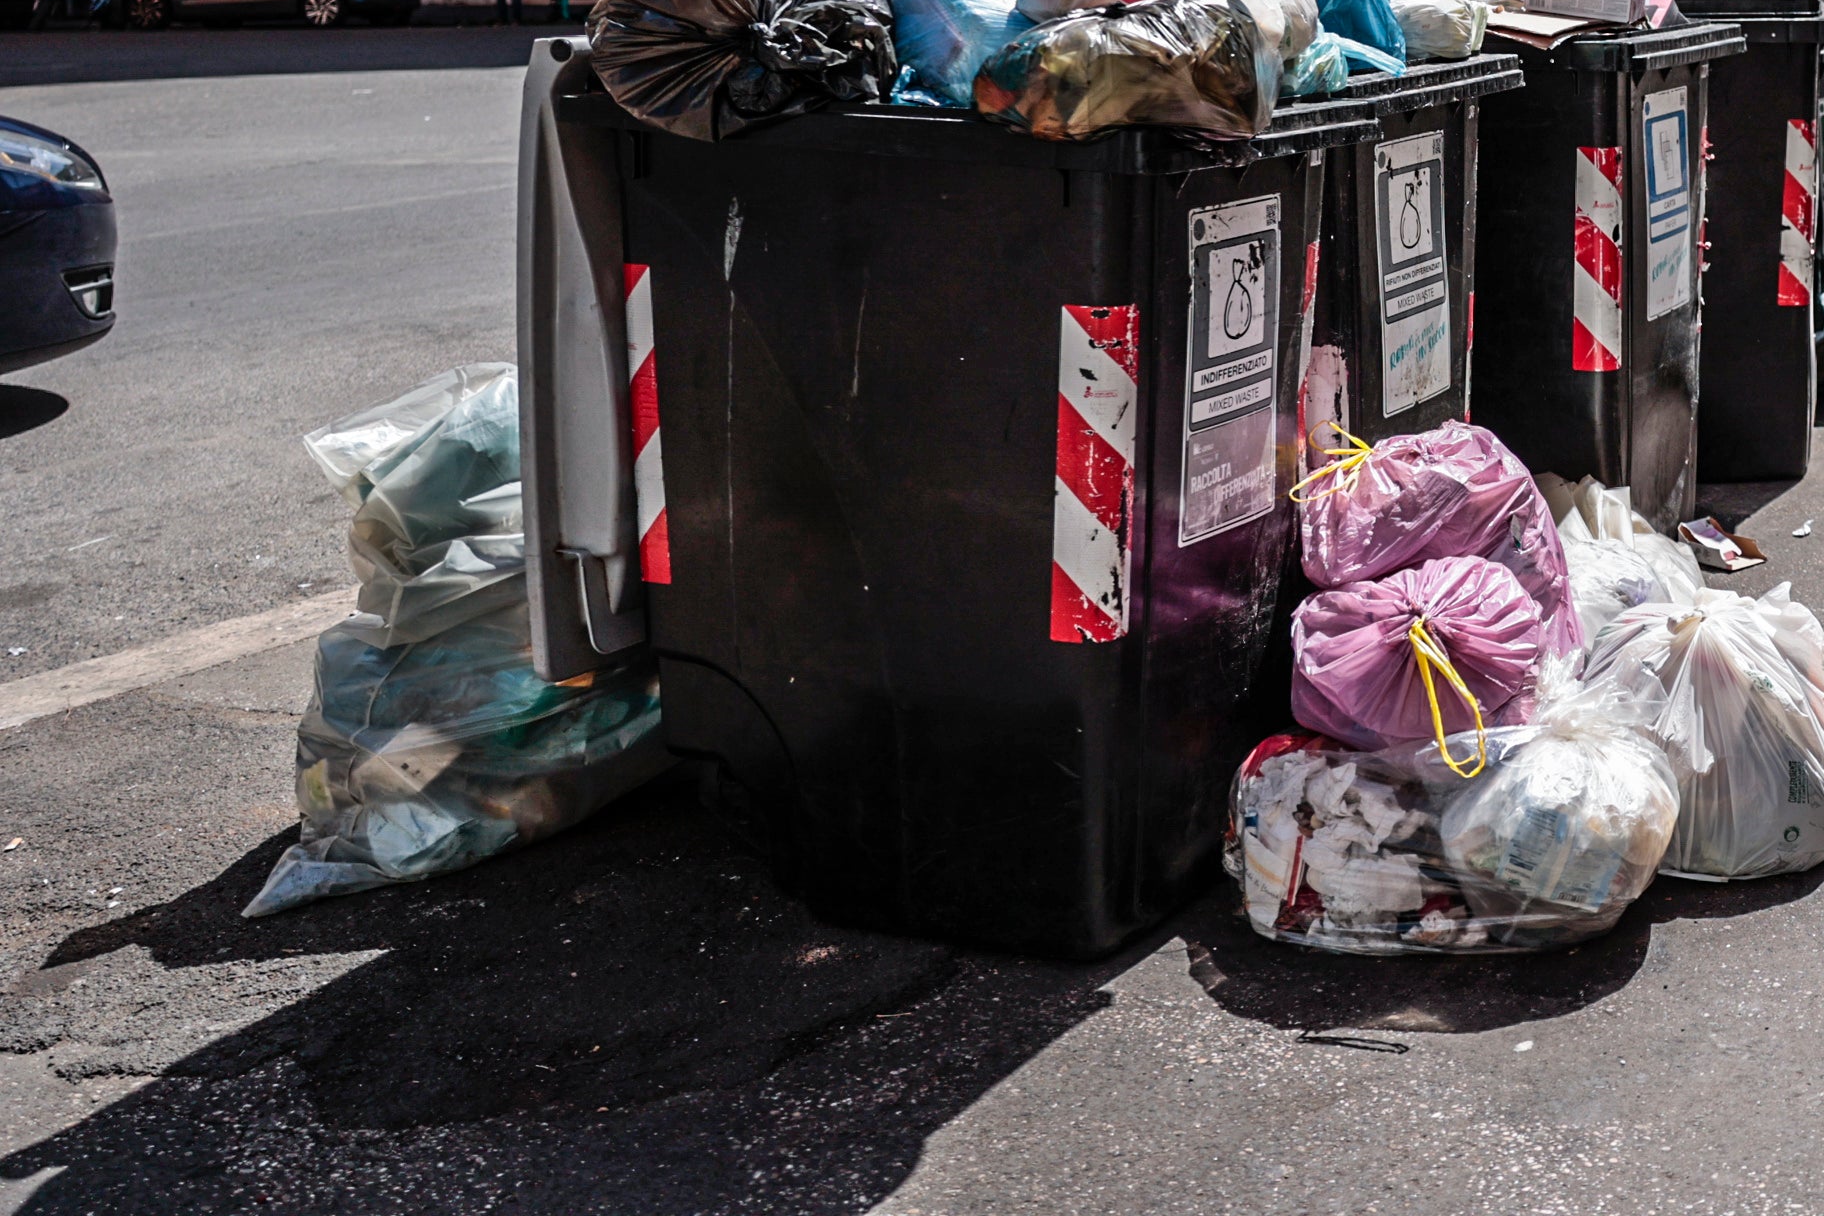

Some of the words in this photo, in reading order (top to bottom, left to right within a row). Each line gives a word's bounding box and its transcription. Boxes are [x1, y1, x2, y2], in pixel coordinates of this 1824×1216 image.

[1402, 272, 1411, 282] NON
[1397, 294, 1415, 309] MIXED
[1415, 288, 1435, 303] WASTE
[1200, 355, 1267, 386] INDIFFERENZIATO
[1208, 396, 1233, 414] MIXED
[1235, 386, 1259, 405] WASTE
[1190, 462, 1232, 495] RACCOLTA
